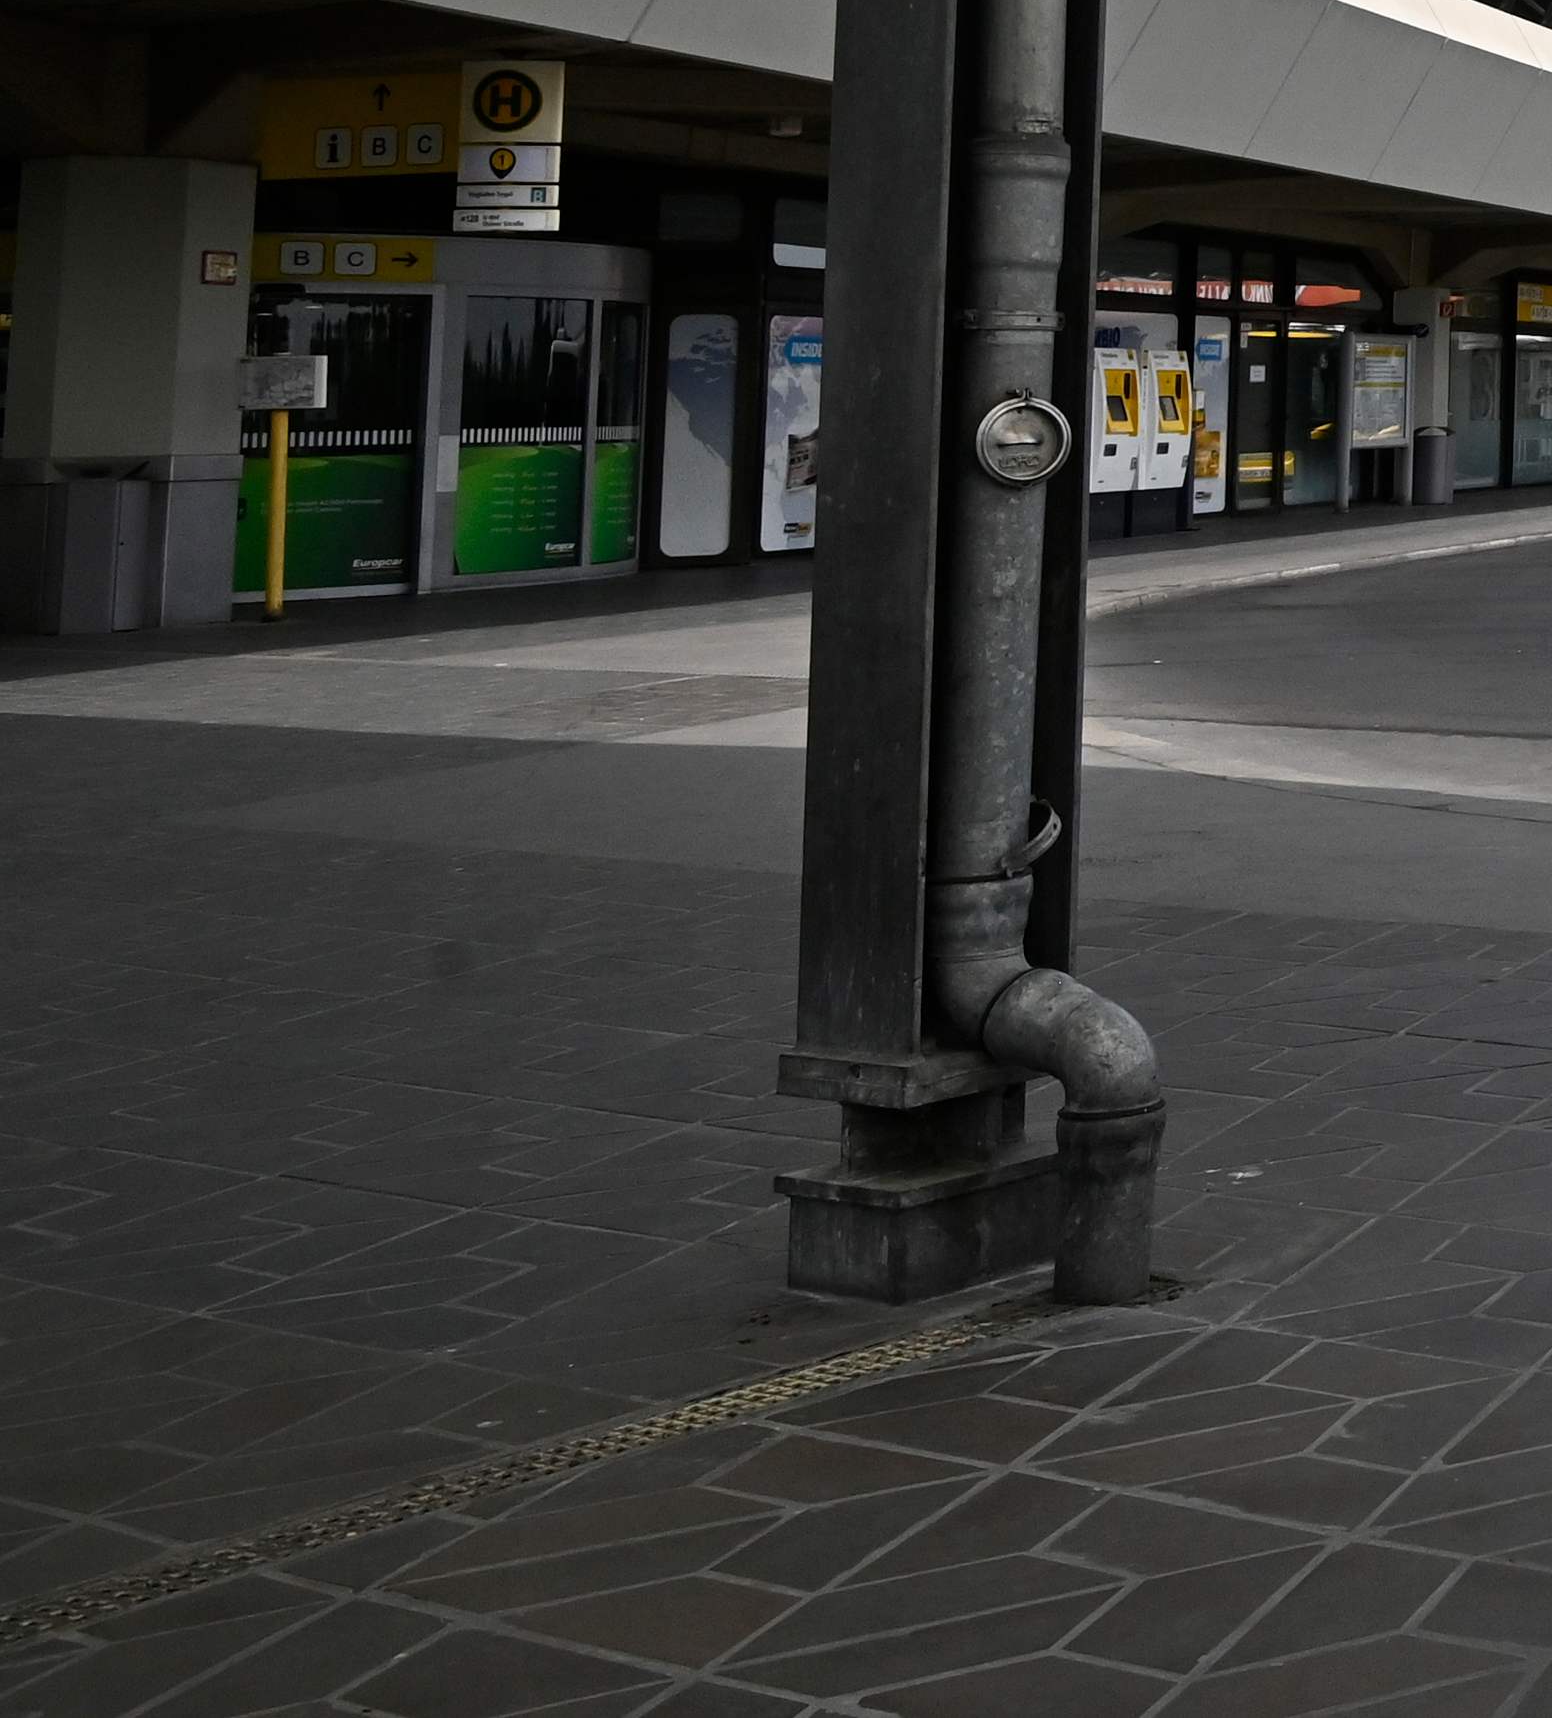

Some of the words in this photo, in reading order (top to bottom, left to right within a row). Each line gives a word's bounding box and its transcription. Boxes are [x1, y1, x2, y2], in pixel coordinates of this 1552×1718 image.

[372, 137, 386, 156] B
[417, 135, 433, 154] C
[294, 250, 310, 266] B
[347, 251, 364, 267] C
[352, 557, 405, 570] Europcar
